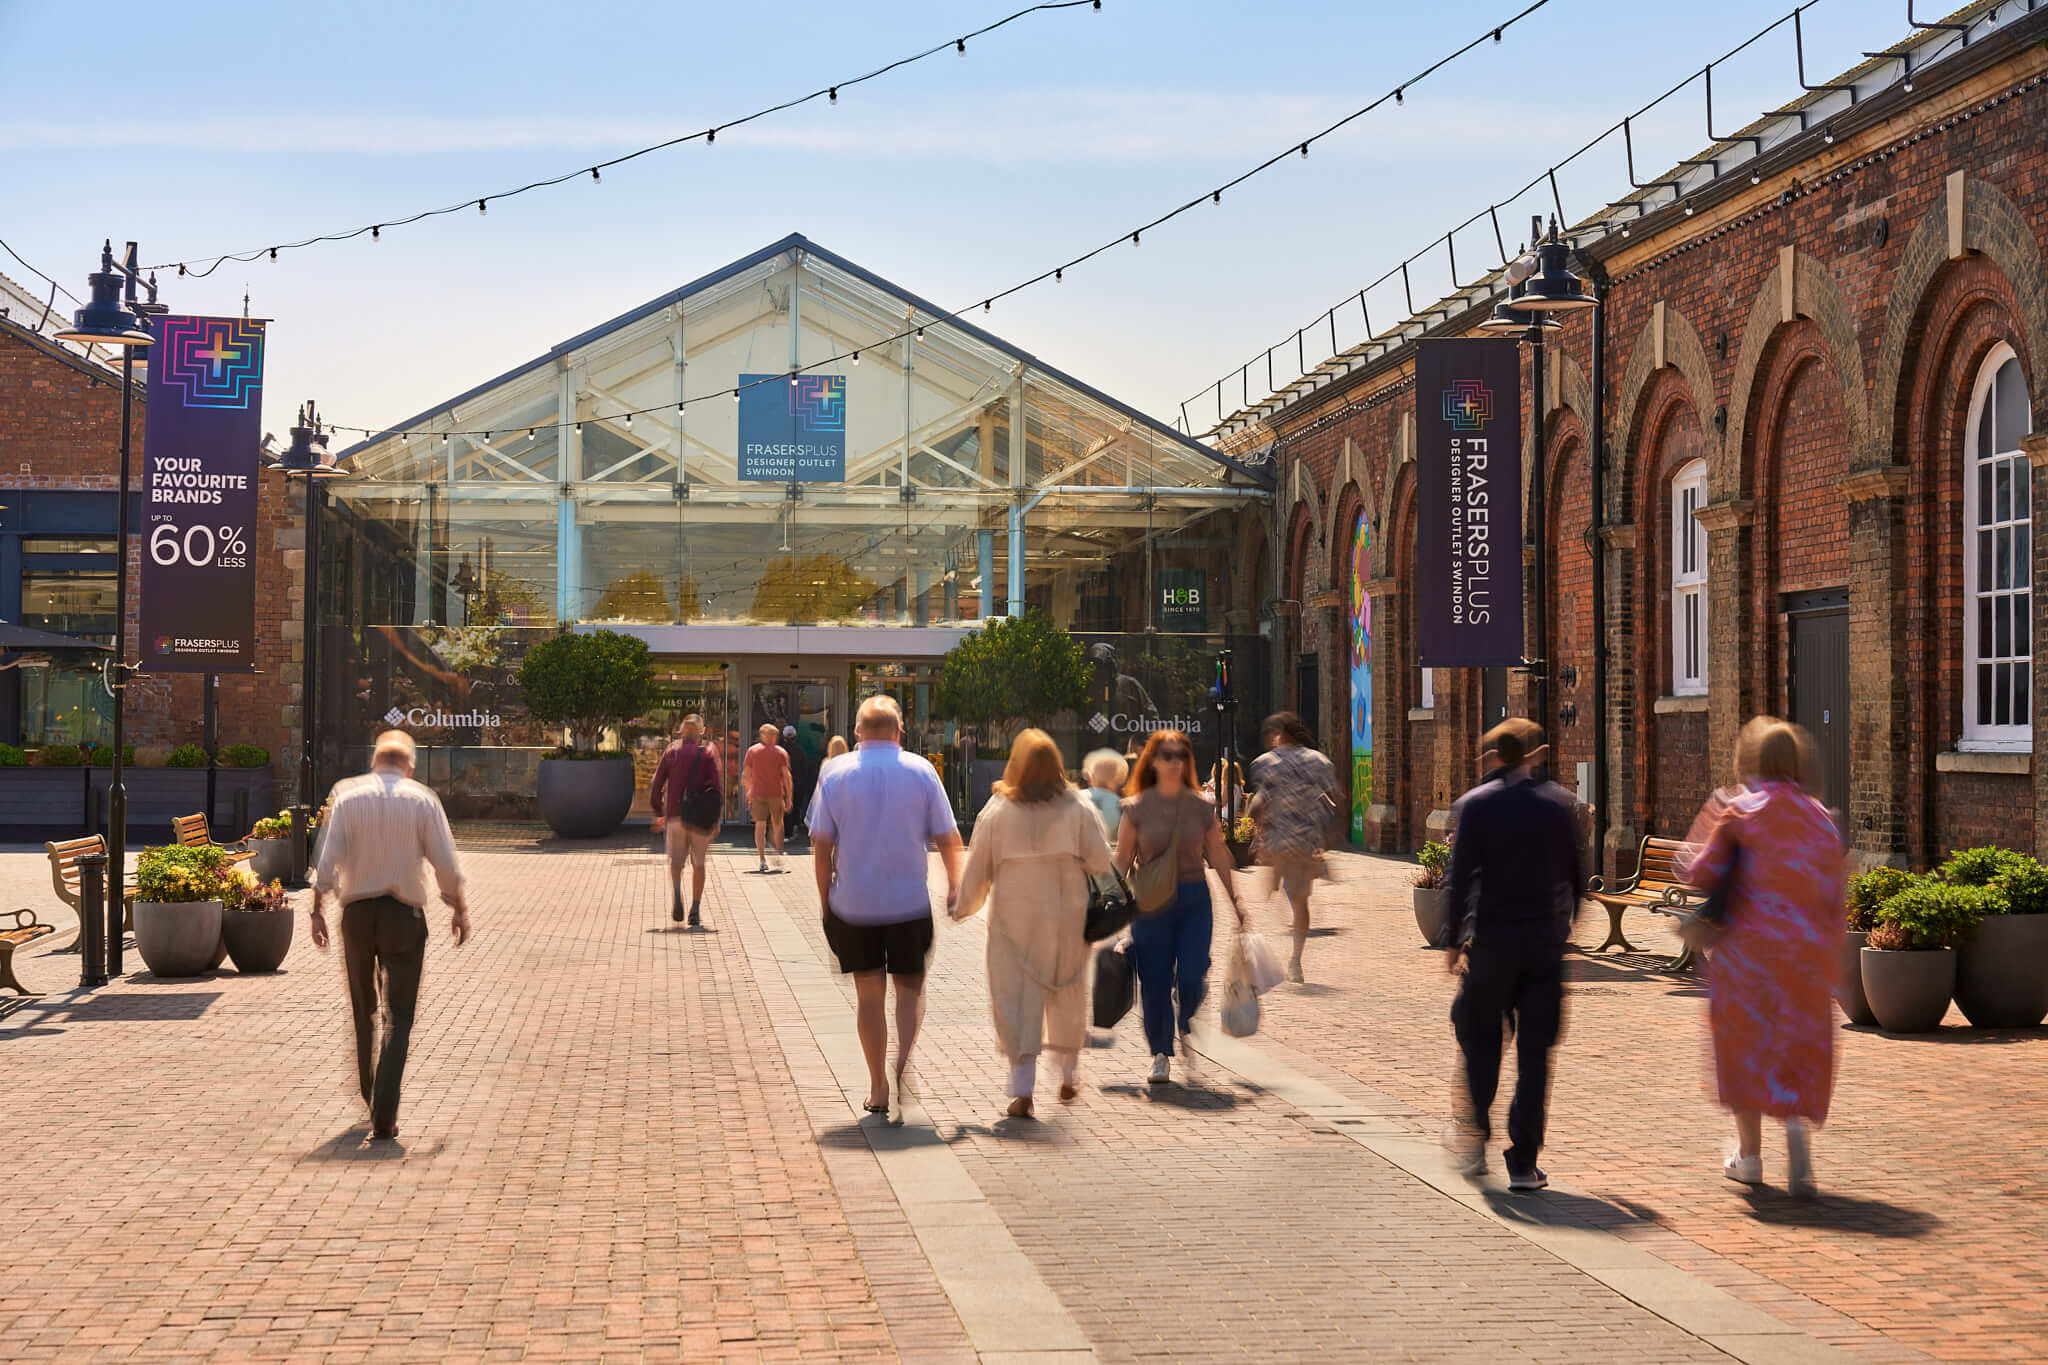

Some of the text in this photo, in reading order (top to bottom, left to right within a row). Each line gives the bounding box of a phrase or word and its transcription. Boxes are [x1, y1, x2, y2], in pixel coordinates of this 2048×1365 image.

[746, 443, 838, 457] FRASERSPLUS
[154, 457, 202, 472] YOUR
[746, 458, 836, 468] DESIGNER OUTLET
[746, 468, 795, 477] SWINDON
[152, 473, 248, 489] FAVOURITE
[151, 488, 222, 504] BRANDS
[1450, 438, 1463, 625] DESIGNER OUTLET SWINDON
[1466, 438, 1490, 625] FRASERSPLUS
[150, 524, 246, 567] 60%
[217, 557, 247, 568] LESS
[1163, 588, 1200, 605] H&B
[175, 639, 240, 649] FRASERSPLUS
[407, 708, 500, 728] Columbia
[1111, 713, 1201, 732] Columbia
